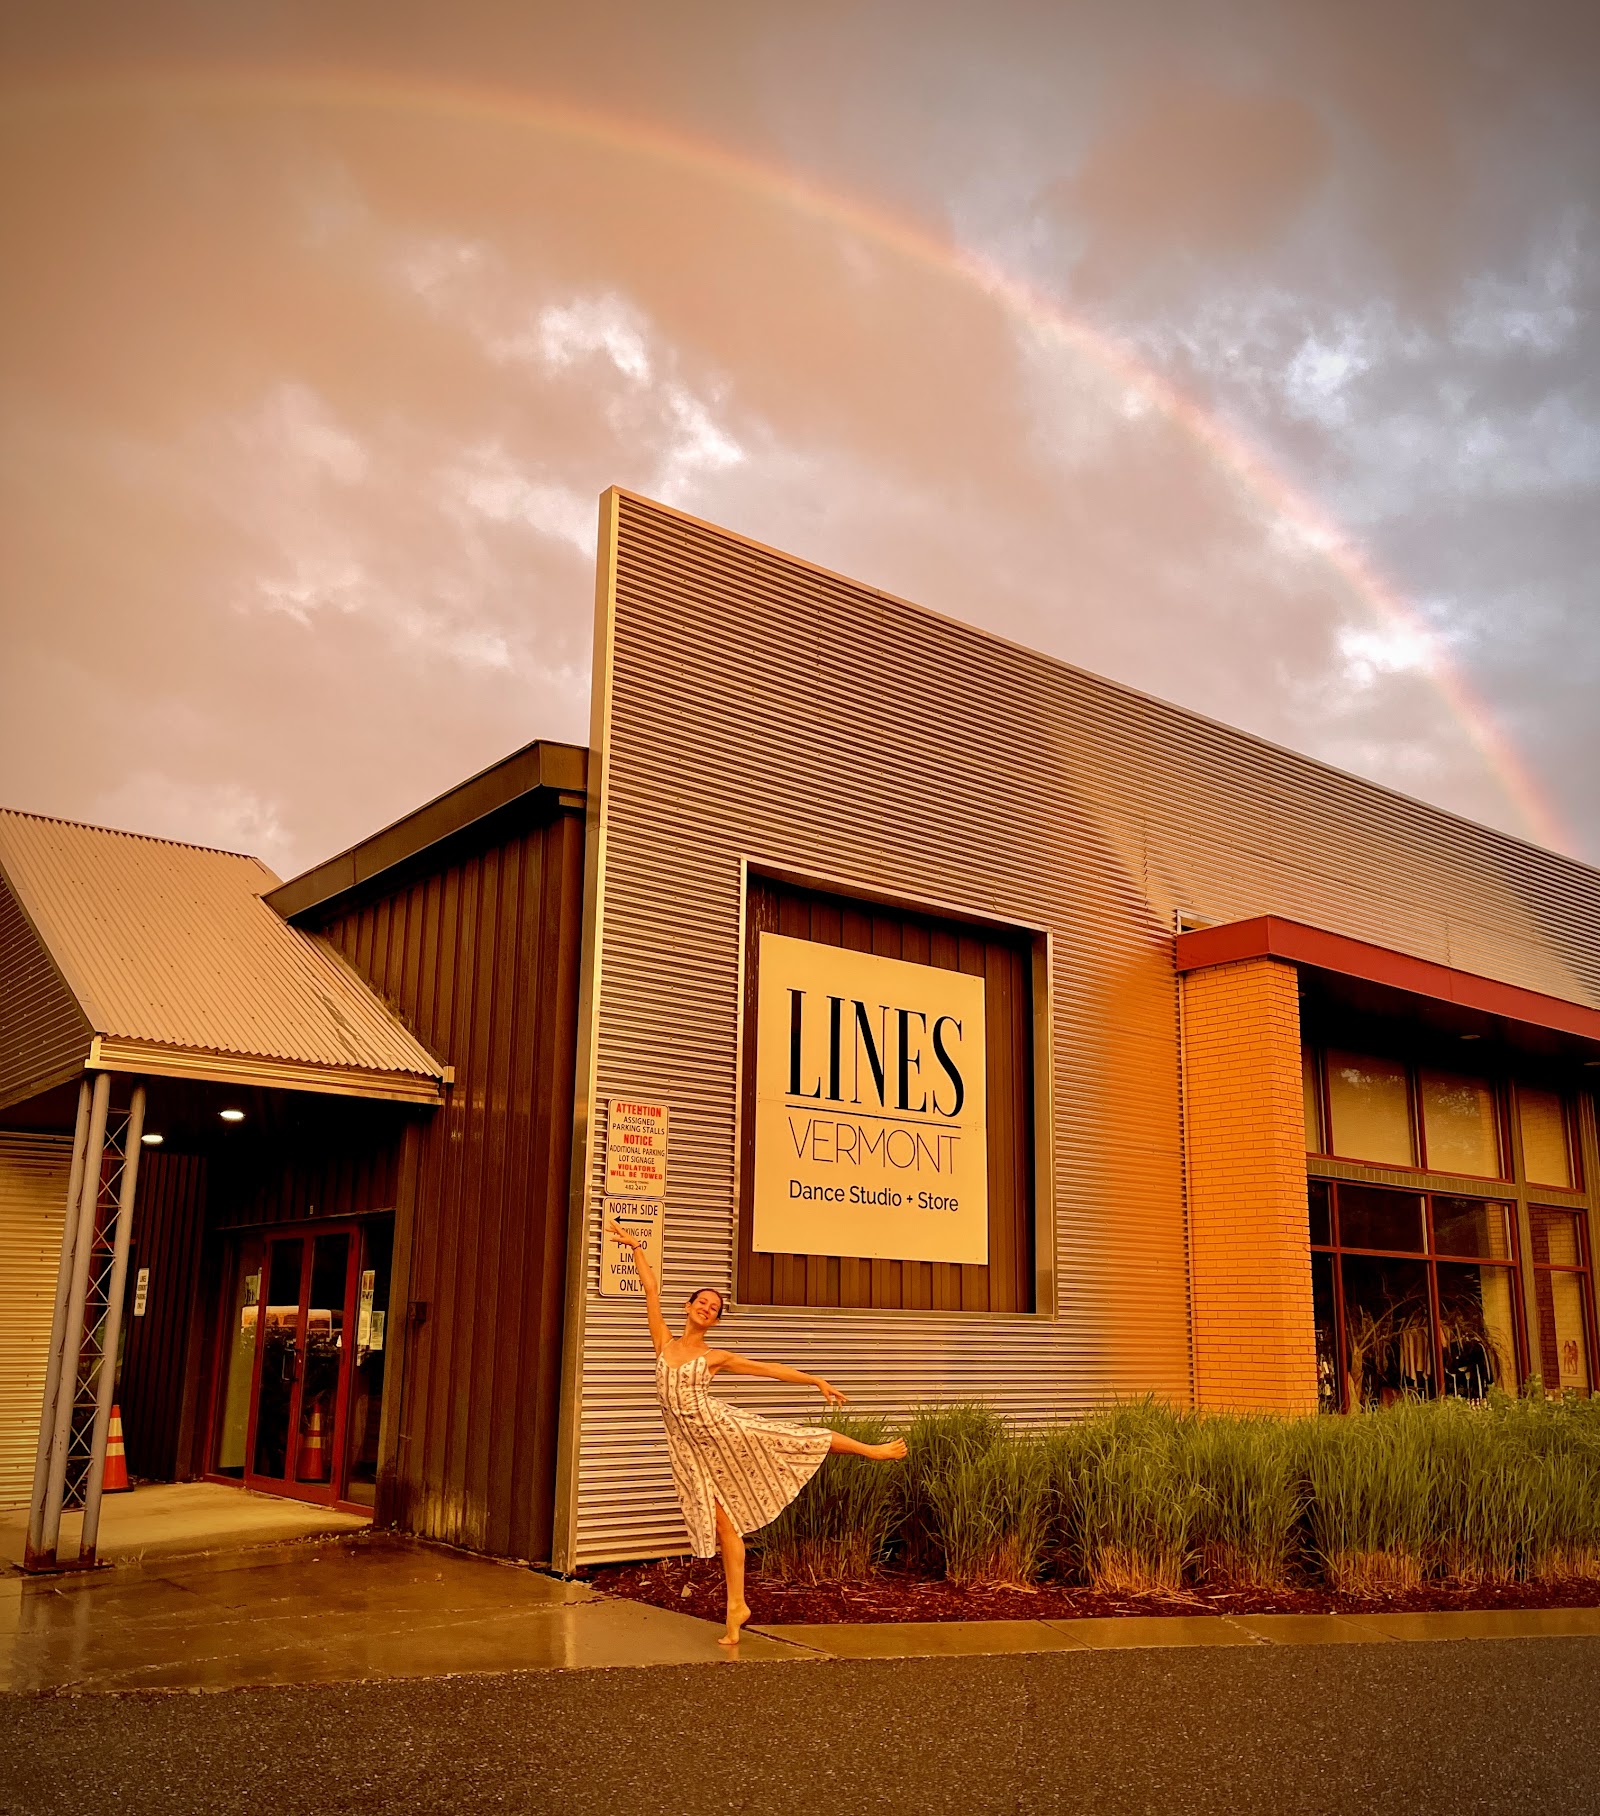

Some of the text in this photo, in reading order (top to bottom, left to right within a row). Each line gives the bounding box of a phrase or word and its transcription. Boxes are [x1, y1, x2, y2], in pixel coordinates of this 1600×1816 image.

[785, 988, 964, 1118] LINES
[616, 1103, 662, 1117] ATTENTION
[623, 1116, 655, 1126] ASSIGNED
[612, 1123, 665, 1135] PARKING STALLS
[623, 1134, 653, 1146] NOTICE
[788, 1116, 961, 1174] VERMONT
[610, 1145, 665, 1157] ADDITIONAL PARKING
[630, 1155, 655, 1164] SIGNAGE
[617, 1164, 656, 1172] VIOLATORS
[640, 1172, 663, 1180] TOWED
[789, 1180, 959, 1212] Dance Studio + Store
[609, 1202, 658, 1216] NORTH SIDE
[640, 1228, 653, 1237] FOR
